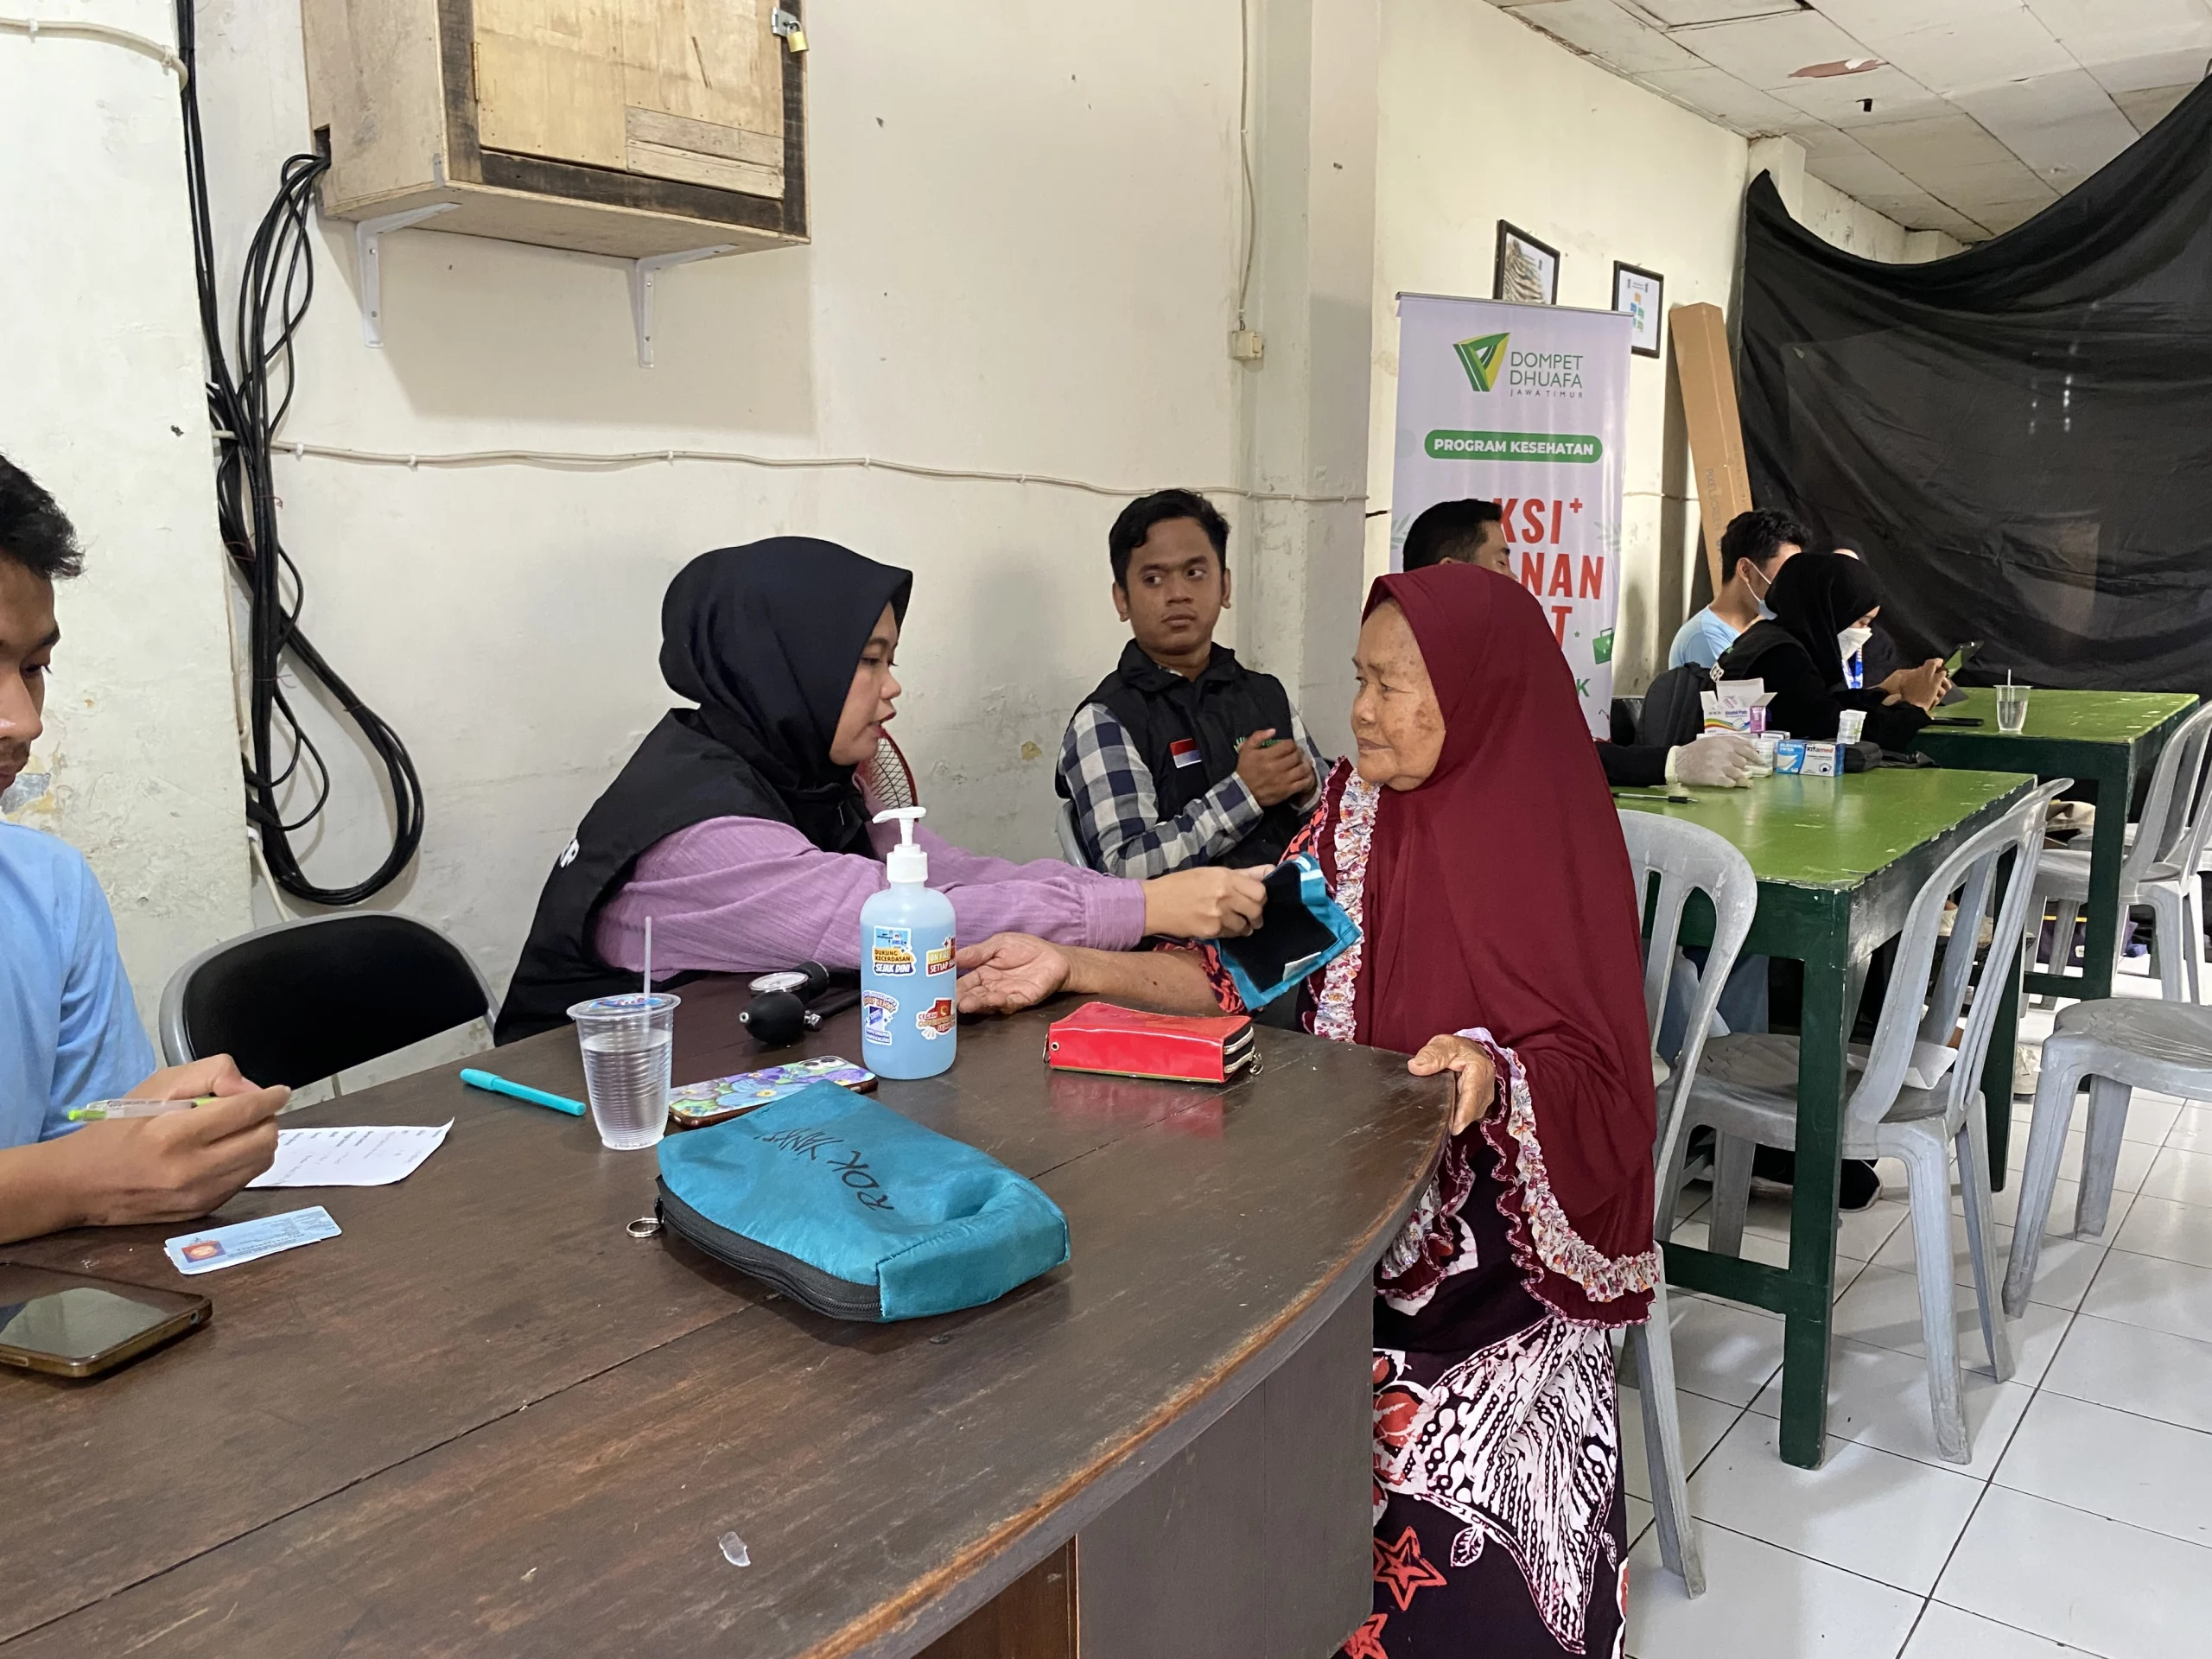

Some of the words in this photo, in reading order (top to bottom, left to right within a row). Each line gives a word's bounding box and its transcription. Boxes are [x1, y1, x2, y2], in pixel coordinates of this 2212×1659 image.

[1510, 352, 1584, 371] DOMPET
[1510, 370, 1583, 389] DHUAFA
[1433, 438, 1506, 454] PROGRAM
[1510, 441, 1594, 456] KESEHATAN
[1492, 498, 1563, 544] KSI
[875, 963, 894, 973] SEJAK
